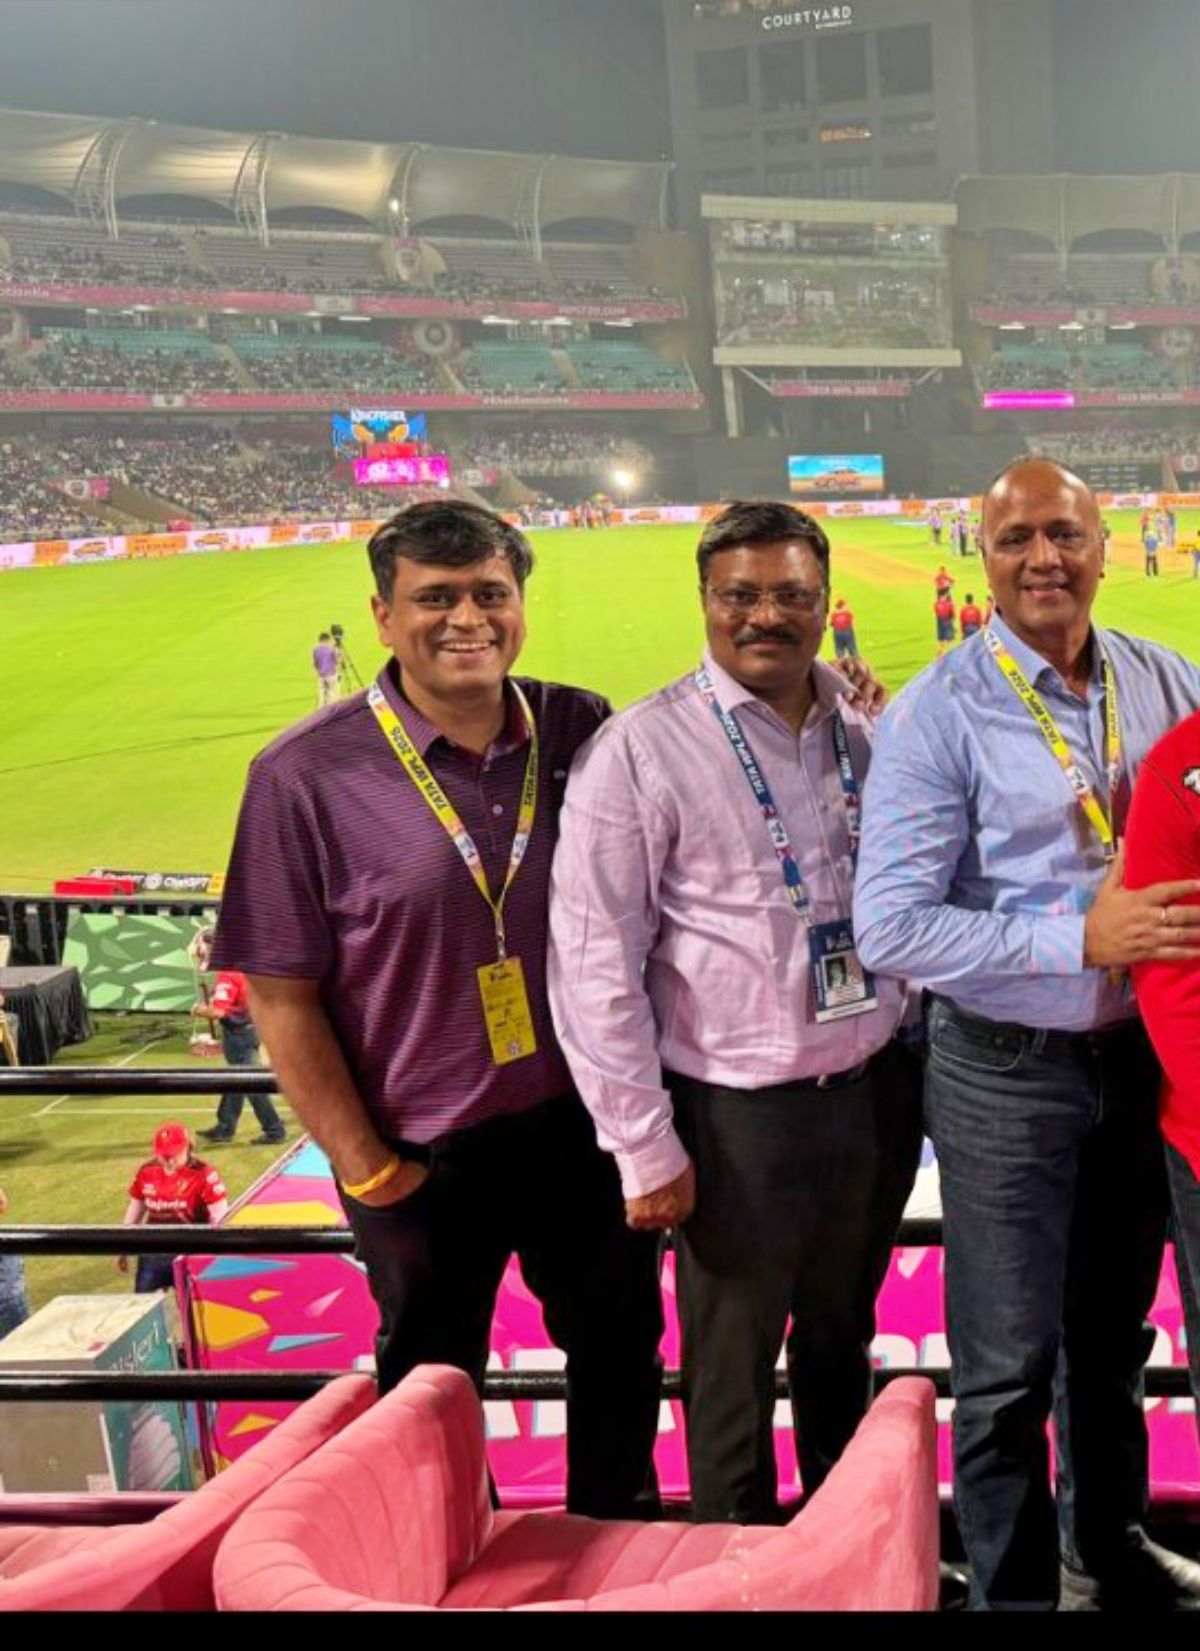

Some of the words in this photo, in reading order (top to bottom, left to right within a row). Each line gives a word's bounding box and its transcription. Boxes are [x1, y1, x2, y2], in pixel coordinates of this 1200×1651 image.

[762, 5, 852, 30] COURTYARD
[406, 754, 428, 783] WPL
[744, 765, 768, 795] TATA
[423, 780, 447, 811] TATA
